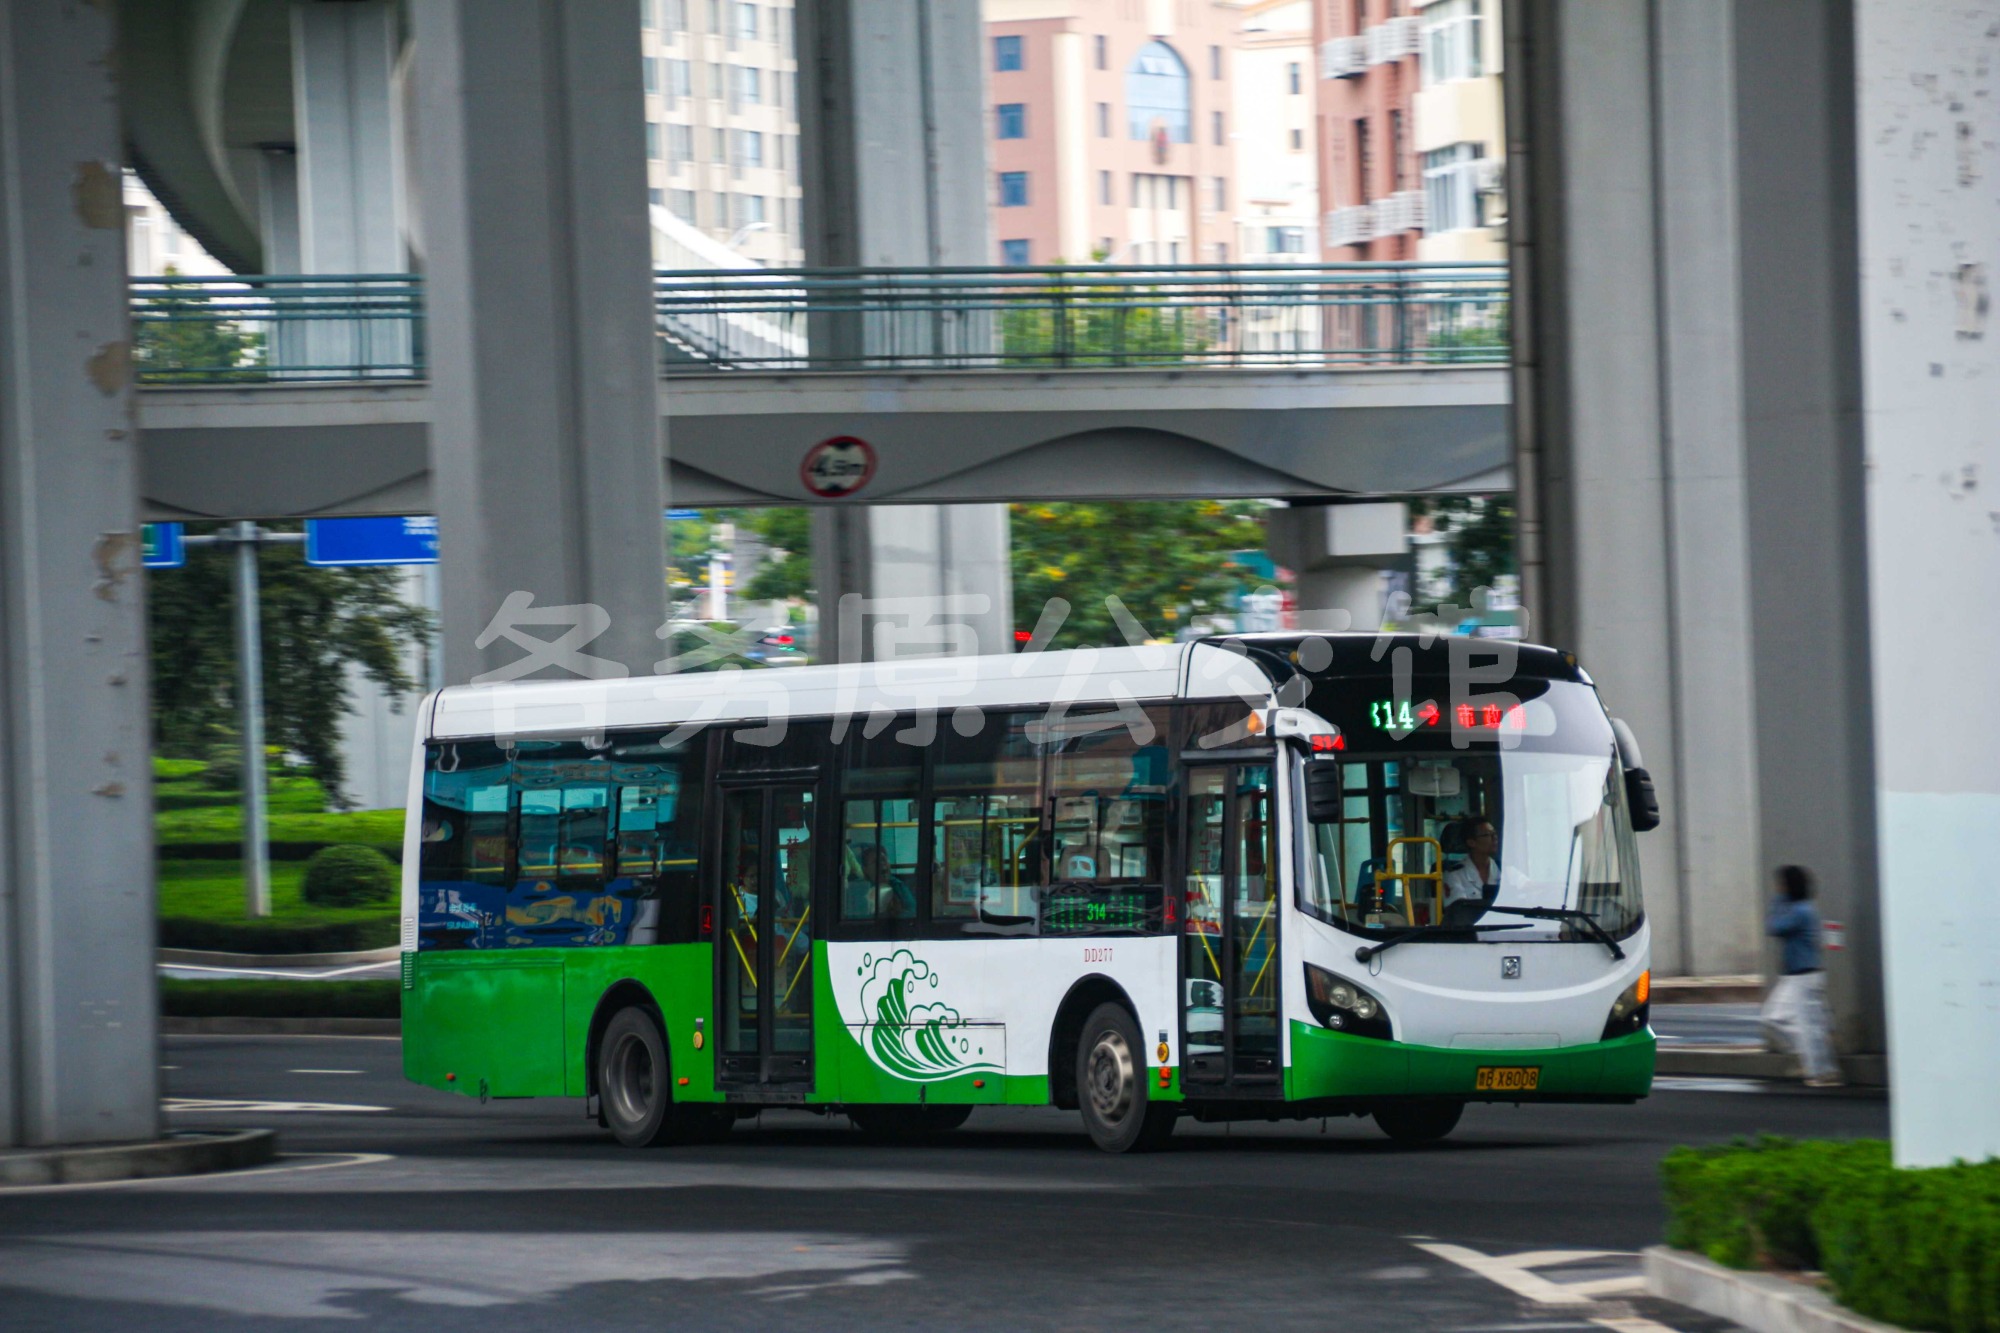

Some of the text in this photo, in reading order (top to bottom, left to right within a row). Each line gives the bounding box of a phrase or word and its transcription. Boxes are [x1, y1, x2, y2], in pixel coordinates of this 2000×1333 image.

[1311, 733, 1345, 750] 314
[1087, 903, 1106, 921] 314
[1084, 948, 1113, 963] DD277
